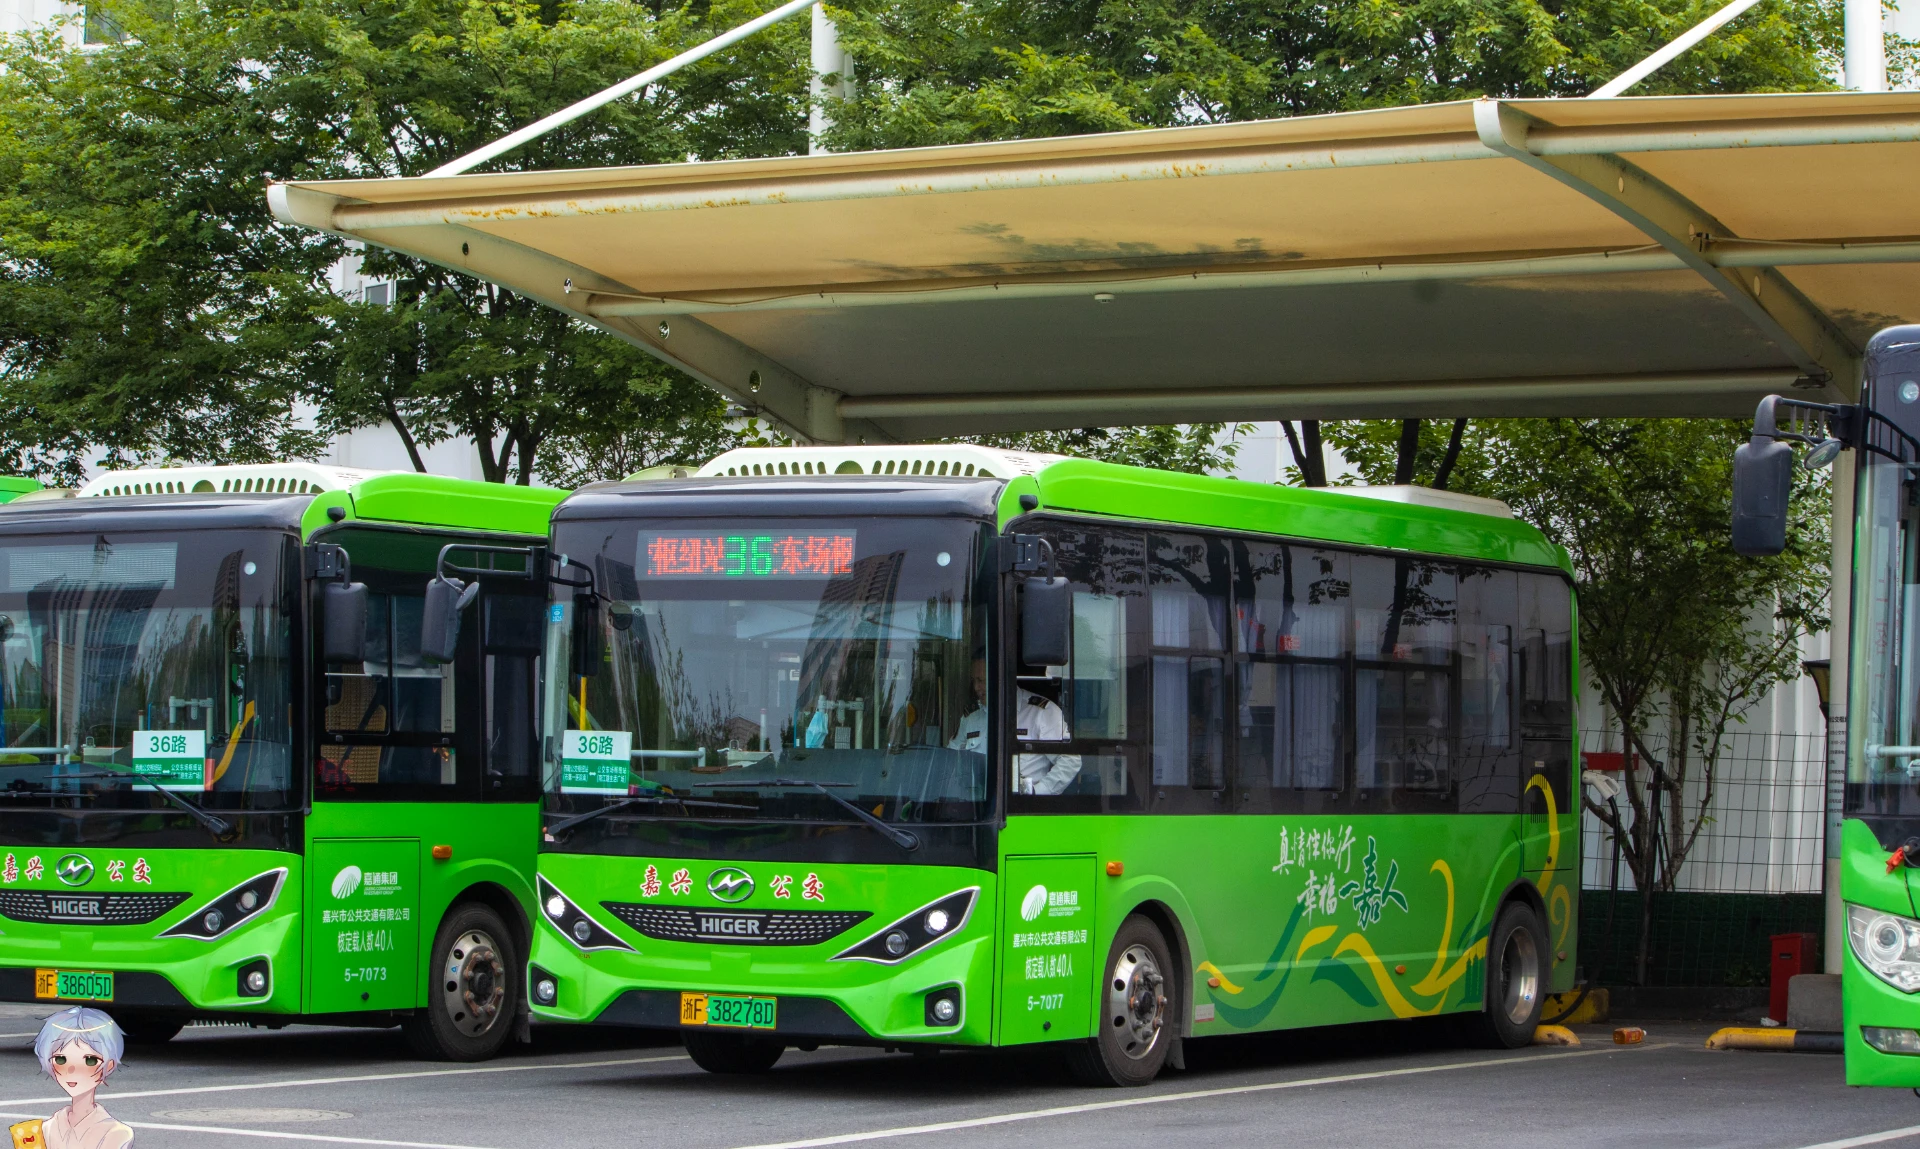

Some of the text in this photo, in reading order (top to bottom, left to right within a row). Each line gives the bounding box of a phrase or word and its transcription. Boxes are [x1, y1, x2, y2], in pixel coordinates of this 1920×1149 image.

[647, 536, 724, 575] 枢纽站
[726, 536, 772, 575] 36
[150, 735, 187, 754] 36路
[577, 735, 613, 755] 36路
[1272, 824, 1356, 875] 真情伴你行
[2, 853, 152, 885] 嘉兴 公交
[363, 871, 398, 886] 嘉通集团
[640, 864, 825, 902] 嘉兴 公交
[51, 900, 100, 915] HIGER
[1048, 890, 1078, 906] 嘉通集团
[322, 907, 410, 924] 嘉兴市公共交通有限公司
[701, 917, 760, 935] HIGER
[337, 929, 395, 953] 核定载人数40人
[1013, 929, 1088, 948] 嘉兴市公共交通有限公司
[344, 966, 387, 982] 5-7073
[1025, 953, 1073, 980] 核定载人数40人
[1027, 993, 1064, 1011] 5-7077
